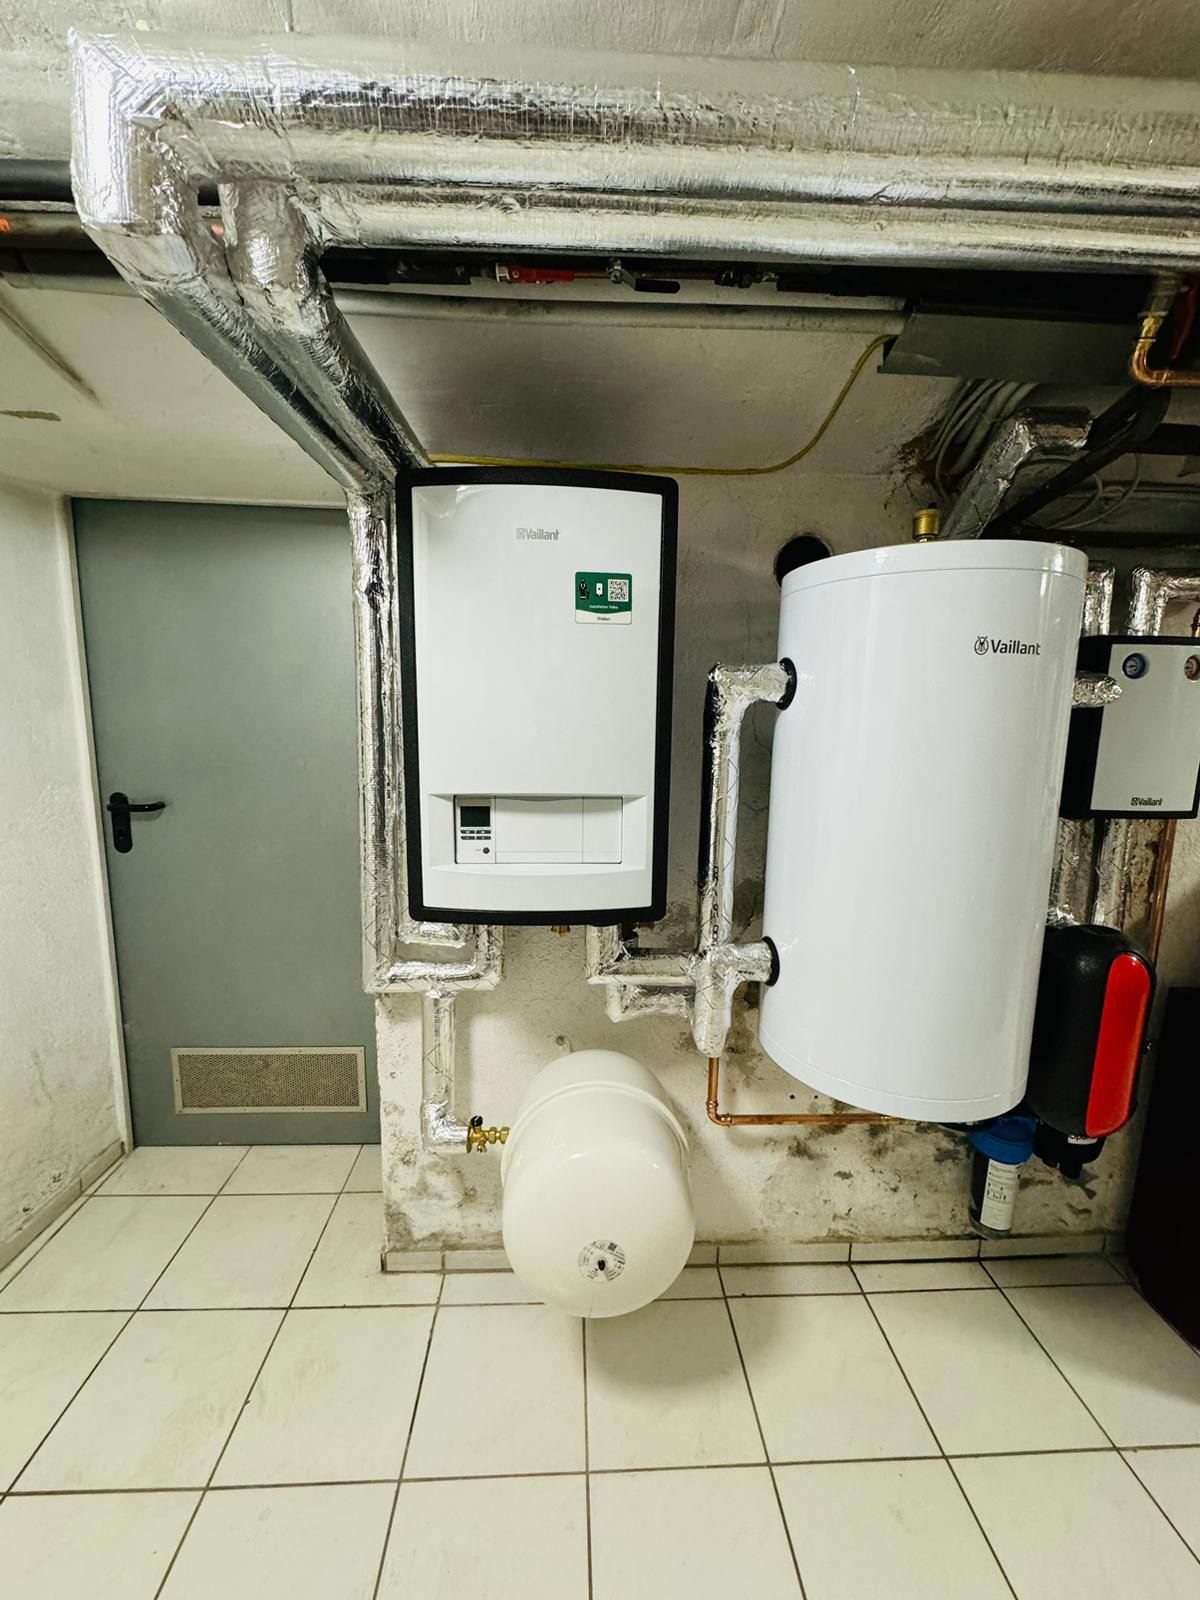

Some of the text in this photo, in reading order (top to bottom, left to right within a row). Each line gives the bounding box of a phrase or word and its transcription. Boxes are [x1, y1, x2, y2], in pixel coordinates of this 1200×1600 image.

[525, 528, 560, 541] Vaillant
[991, 639, 1041, 655] Vaillant
[1138, 797, 1163, 806] Vaillant
